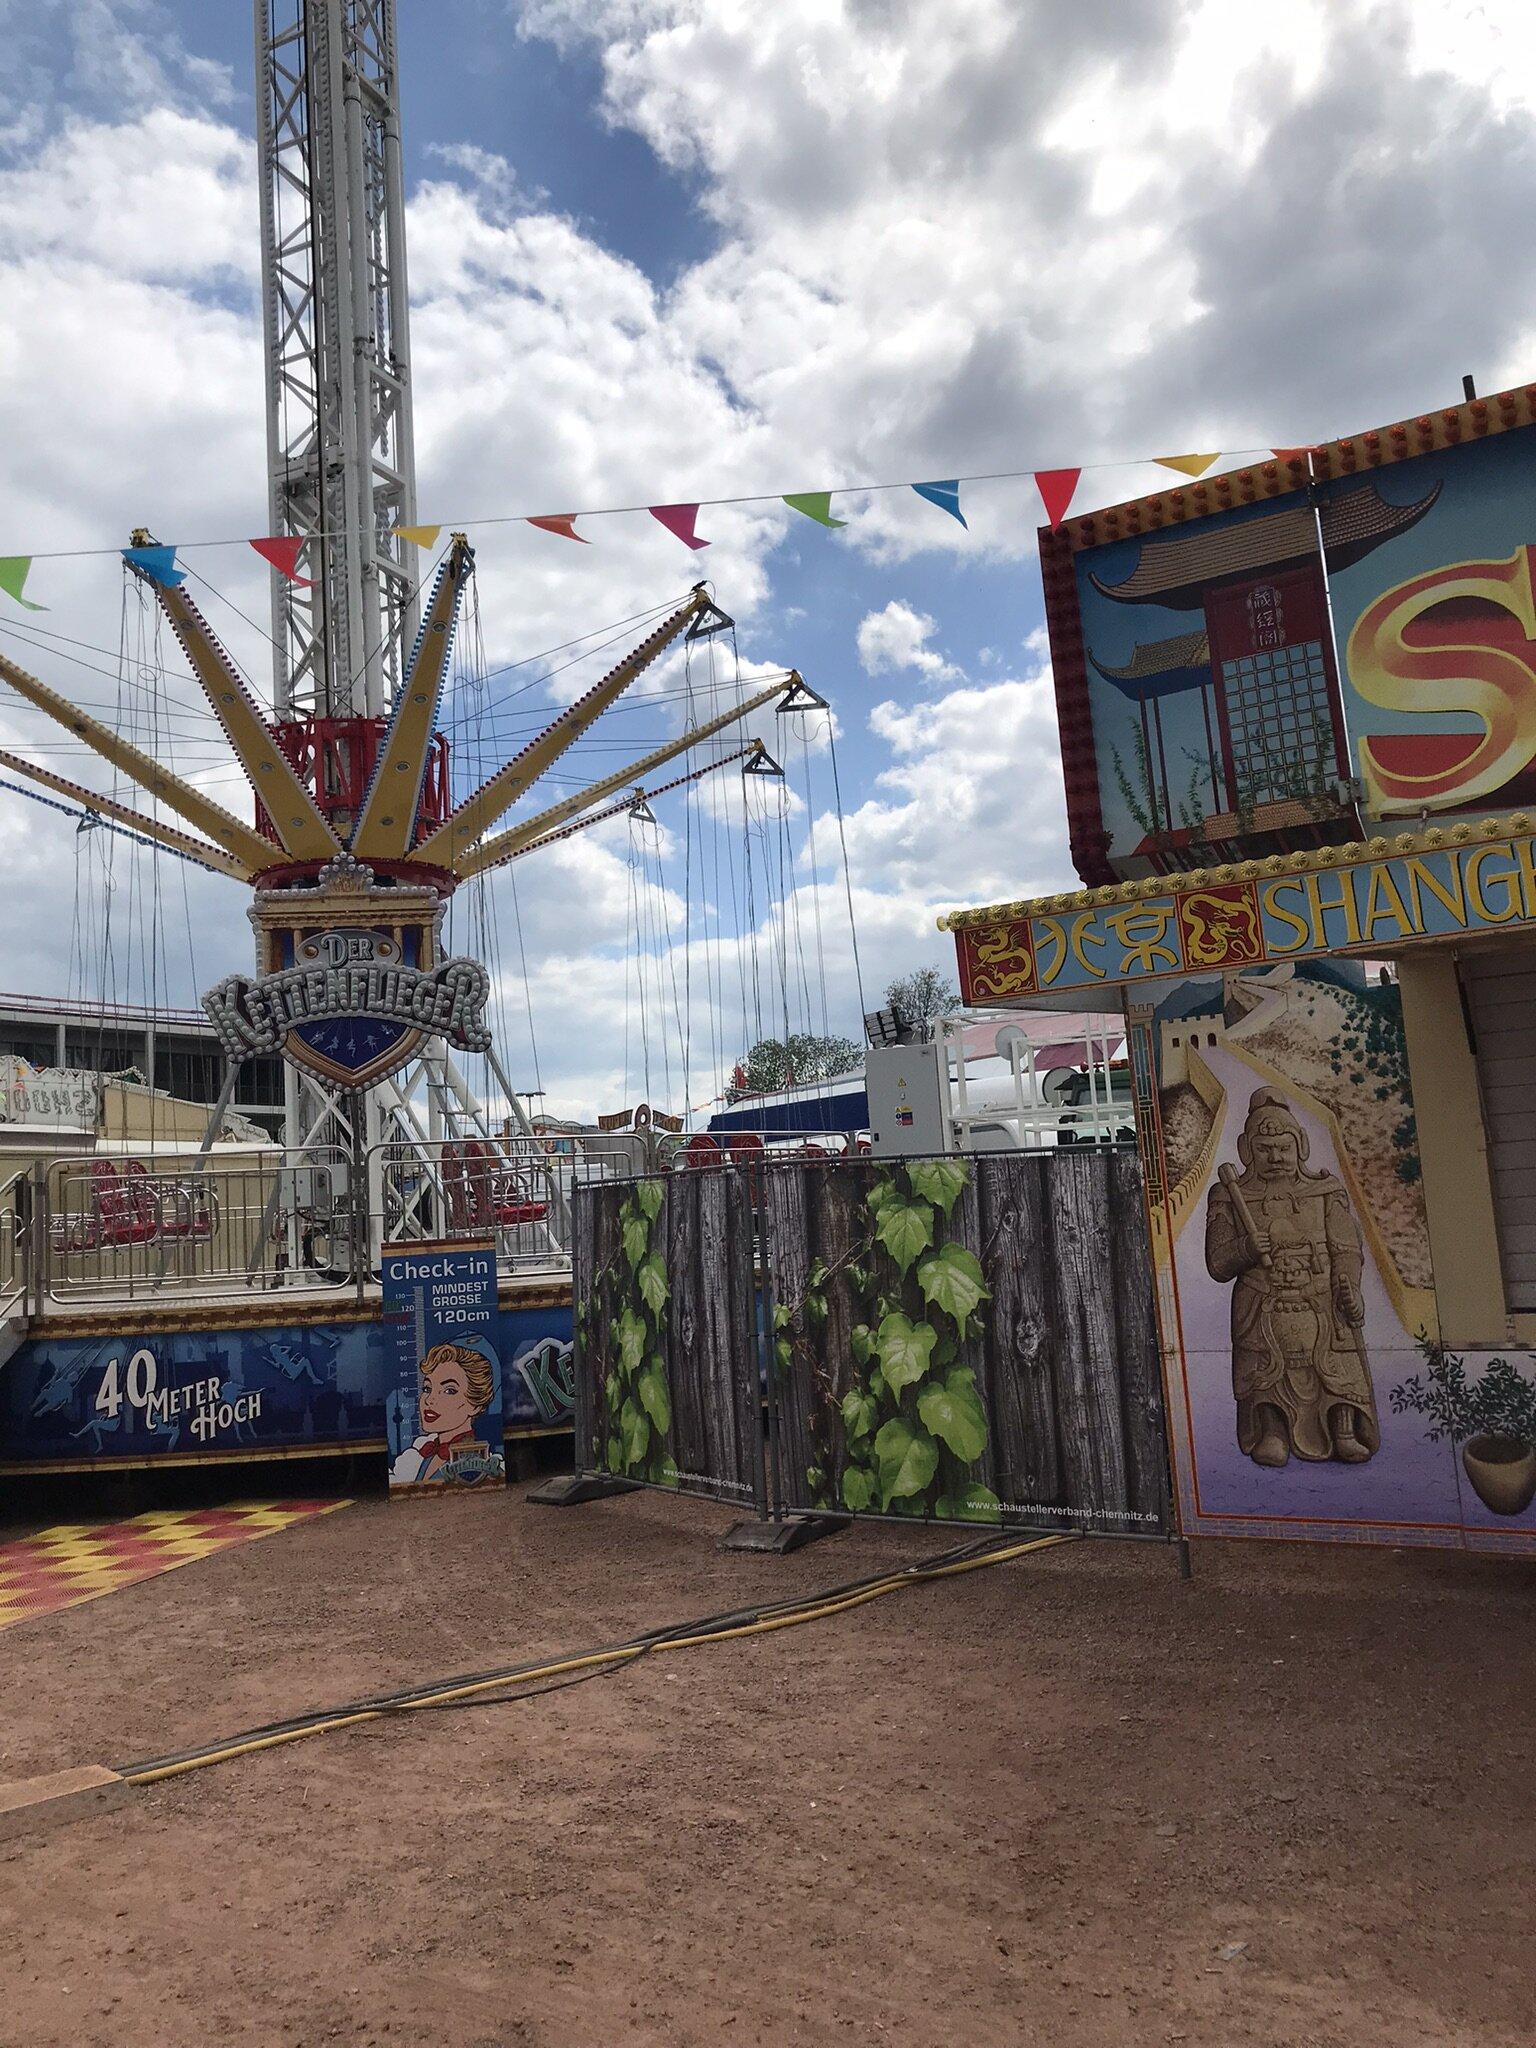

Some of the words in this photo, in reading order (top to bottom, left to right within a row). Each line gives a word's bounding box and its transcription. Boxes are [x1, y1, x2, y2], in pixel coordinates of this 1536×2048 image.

[320, 933, 374, 968] DER
[206, 961, 490, 1056] KETTENFLIEGER
[389, 1257, 488, 1280] Check-in
[432, 1281, 489, 1295] MINDEST
[432, 1293, 482, 1307] GROSSE
[433, 1310, 490, 1324] 120cm
[95, 1349, 157, 1418] 40
[145, 1375, 221, 1430] METER
[190, 1392, 262, 1442] HOCH
[966, 1500, 1160, 1522] www.schaustellerverband-chemnitz.de
